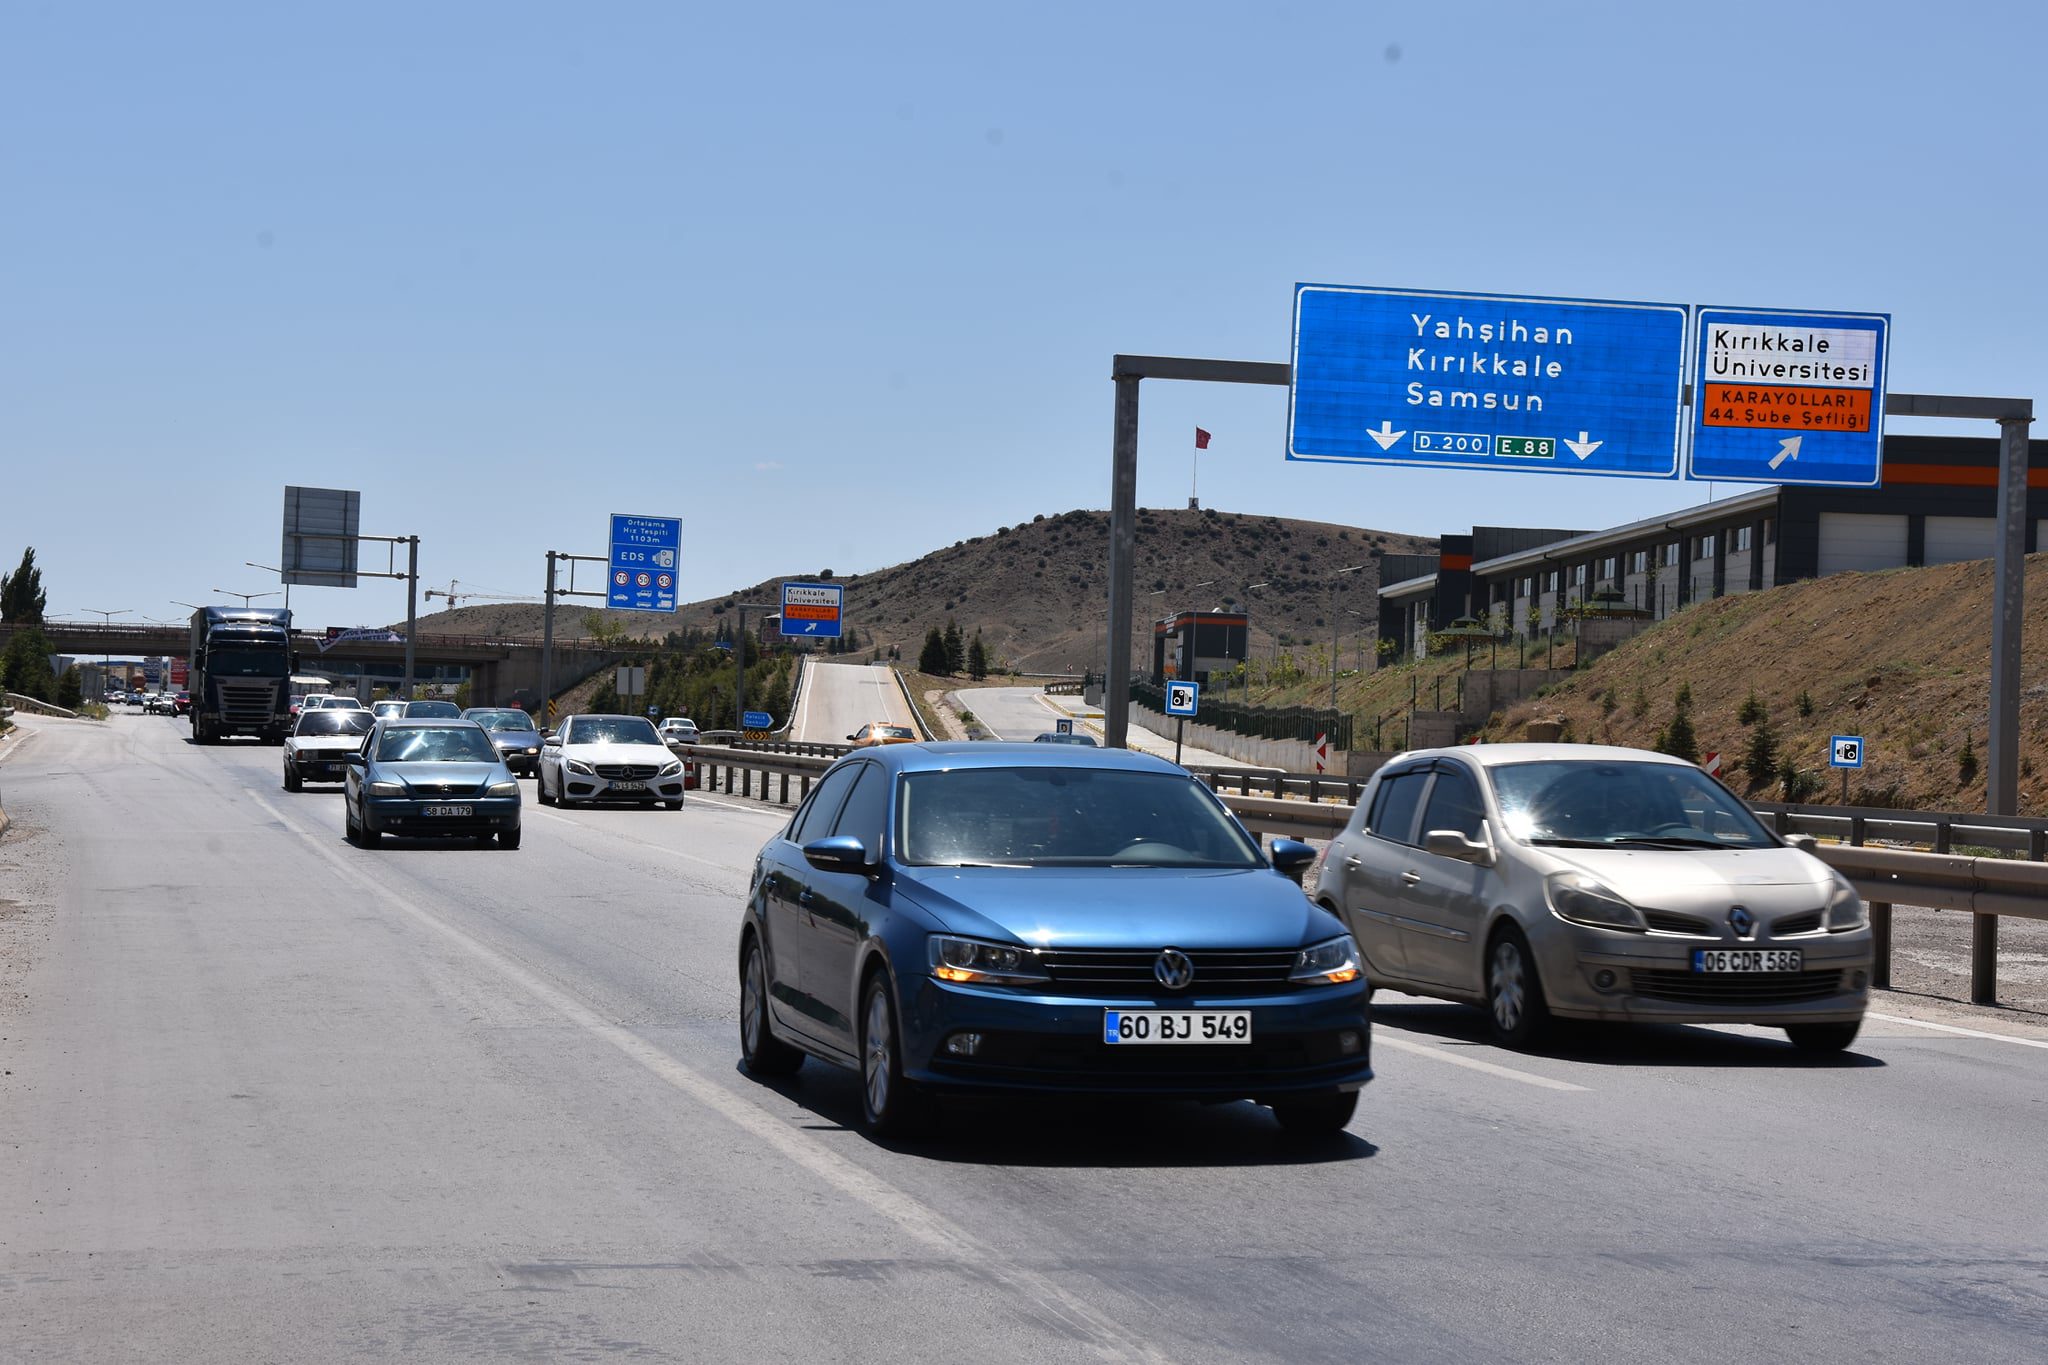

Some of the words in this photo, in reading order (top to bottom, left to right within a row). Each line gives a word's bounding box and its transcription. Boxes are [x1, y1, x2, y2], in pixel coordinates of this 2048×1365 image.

[1411, 313, 1573, 345] Yahşihan
[1715, 330, 1830, 353] Kırıkkale
[1407, 347, 1563, 378] Kırıkkale
[1713, 351, 1868, 381] Üniversitesi
[1406, 381, 1544, 412] Samsun
[1721, 390, 1855, 409] KARAYOLLARI
[1710, 408, 1740, 422] 44.
[1745, 408, 1792, 424] Şube
[1802, 411, 1866, 429] Şefliği
[1419, 435, 1484, 452] D.200
[1501, 439, 1550, 456] E.88
[627, 519, 666, 529] Ortalama
[640, 528, 669, 537] Tespiti
[630, 535, 660, 544] 1103m
[621, 551, 646, 562] EDS
[426, 807, 437, 816] 58
[440, 807, 453, 816] DA
[456, 807, 471, 816] 179
[1705, 952, 1726, 971] 06
[1730, 952, 1763, 971] CDR
[1767, 951, 1800, 971] 586
[1108, 1029, 1119, 1037] TR
[1119, 1015, 1150, 1039] 60
[1160, 1015, 1192, 1039] BJ
[1202, 1015, 1248, 1039] 549
